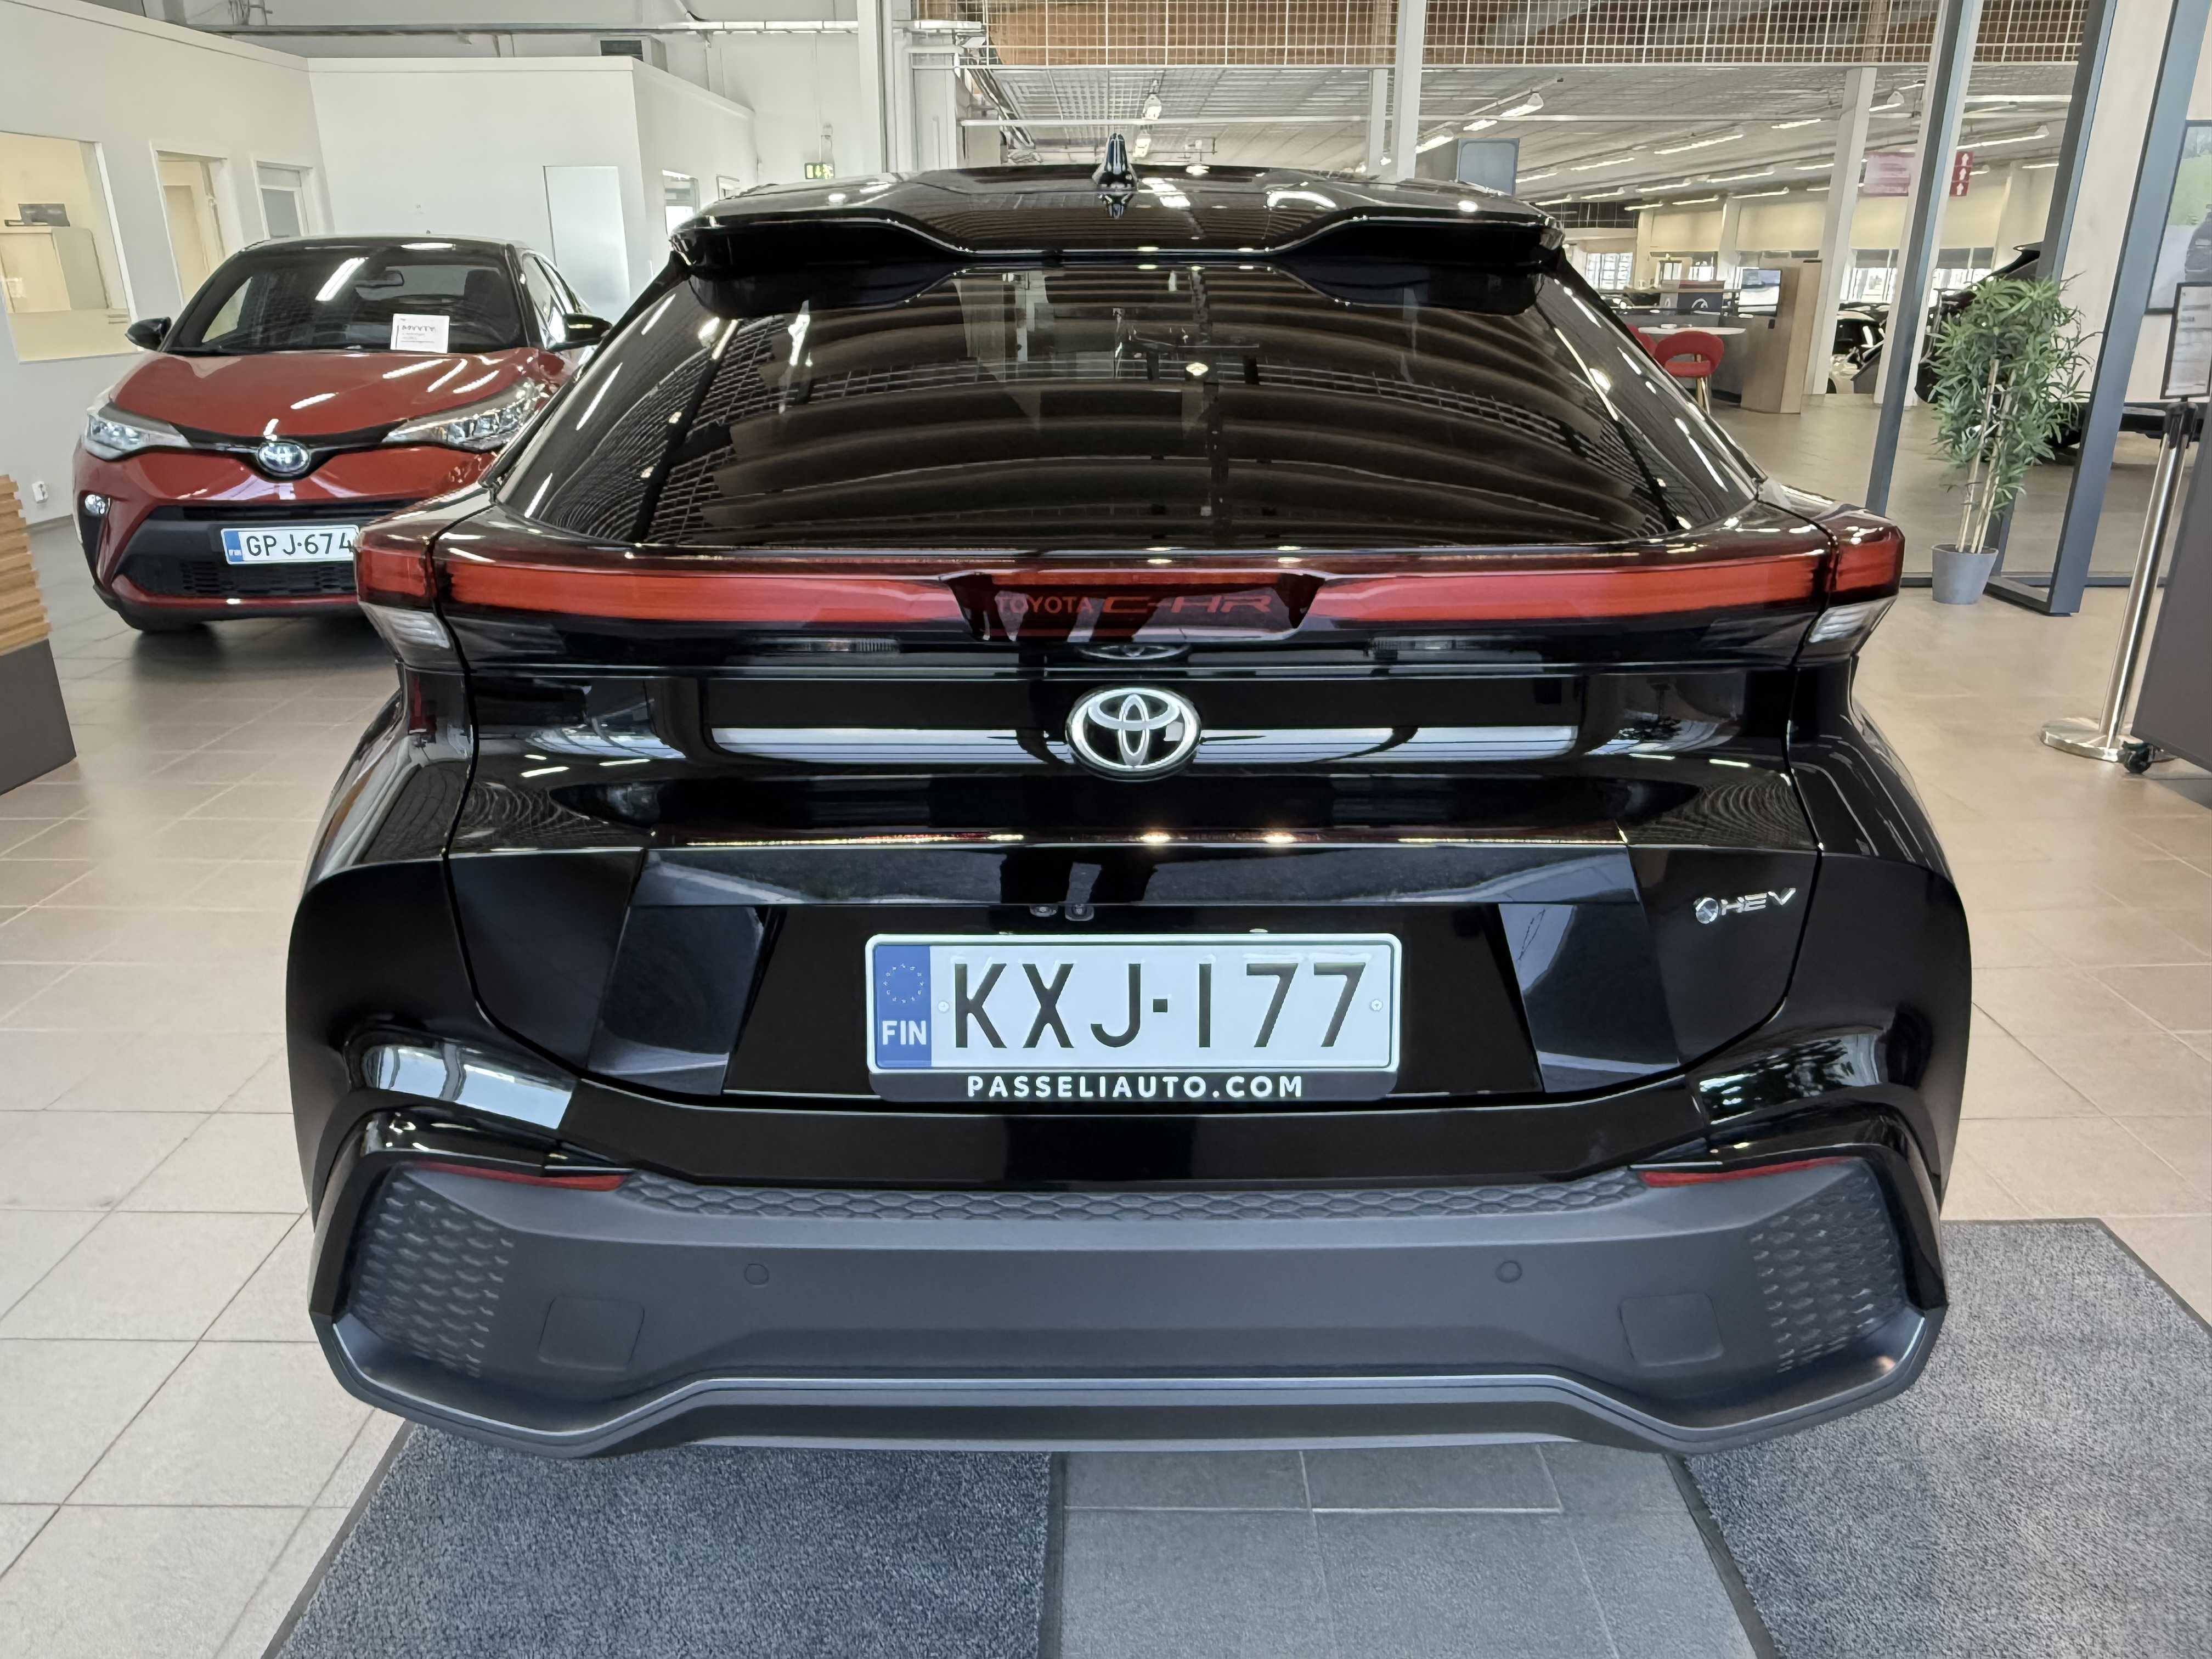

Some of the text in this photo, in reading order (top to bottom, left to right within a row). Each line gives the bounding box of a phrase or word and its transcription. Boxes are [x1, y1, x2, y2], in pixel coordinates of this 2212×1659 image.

[246, 533, 352, 556] GPJ-674
[997, 595, 1272, 614] TOYOTA C-HR
[1720, 888, 1796, 916] HEV
[882, 963, 1366, 1048] FIN KXJ-177
[967, 1075, 1303, 1099] PASSELIAUTO.COM
